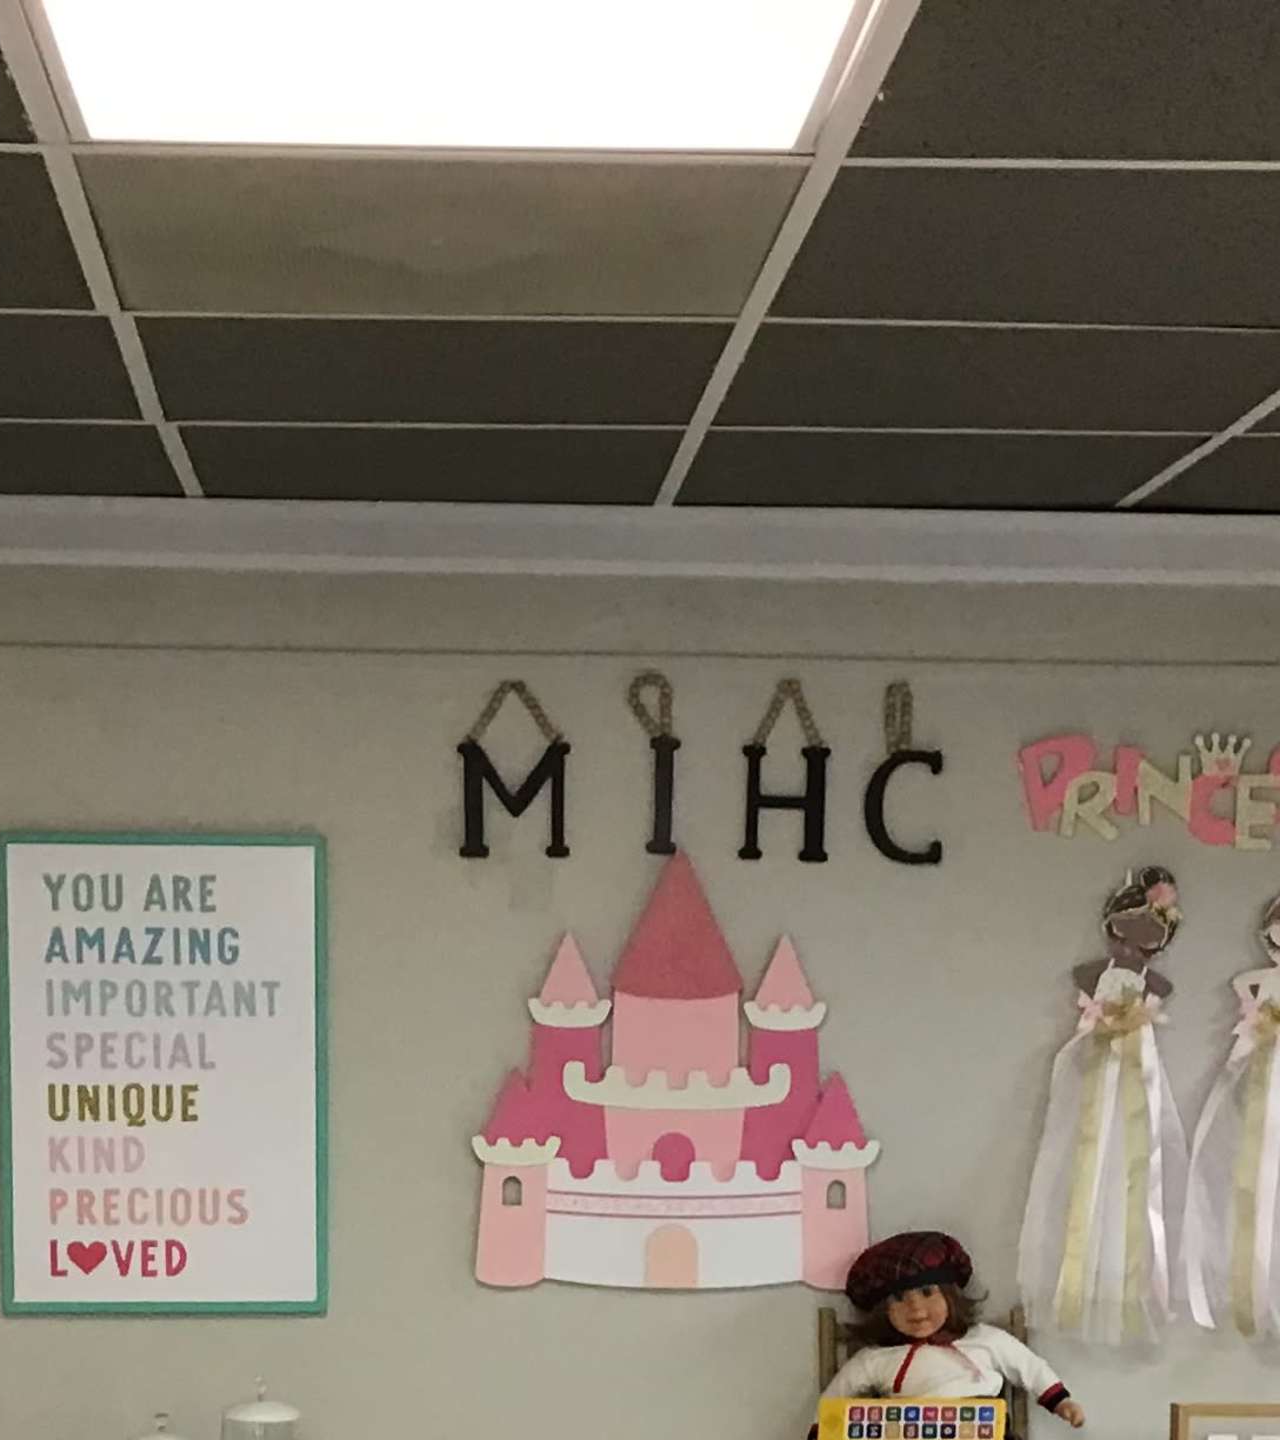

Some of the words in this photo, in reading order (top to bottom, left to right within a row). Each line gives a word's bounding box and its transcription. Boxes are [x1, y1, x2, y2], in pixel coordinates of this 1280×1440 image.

[42, 873, 124, 912] YOU
[143, 874, 218, 913] ARE
[43, 926, 241, 966] AMAZING
[45, 979, 282, 1018] IMPORTANT
[46, 1032, 217, 1070] SPECIAL
[48, 1083, 200, 1127] UNIQUE
[49, 1136, 146, 1174] KIND
[49, 1188, 250, 1226] PRECIOUS
